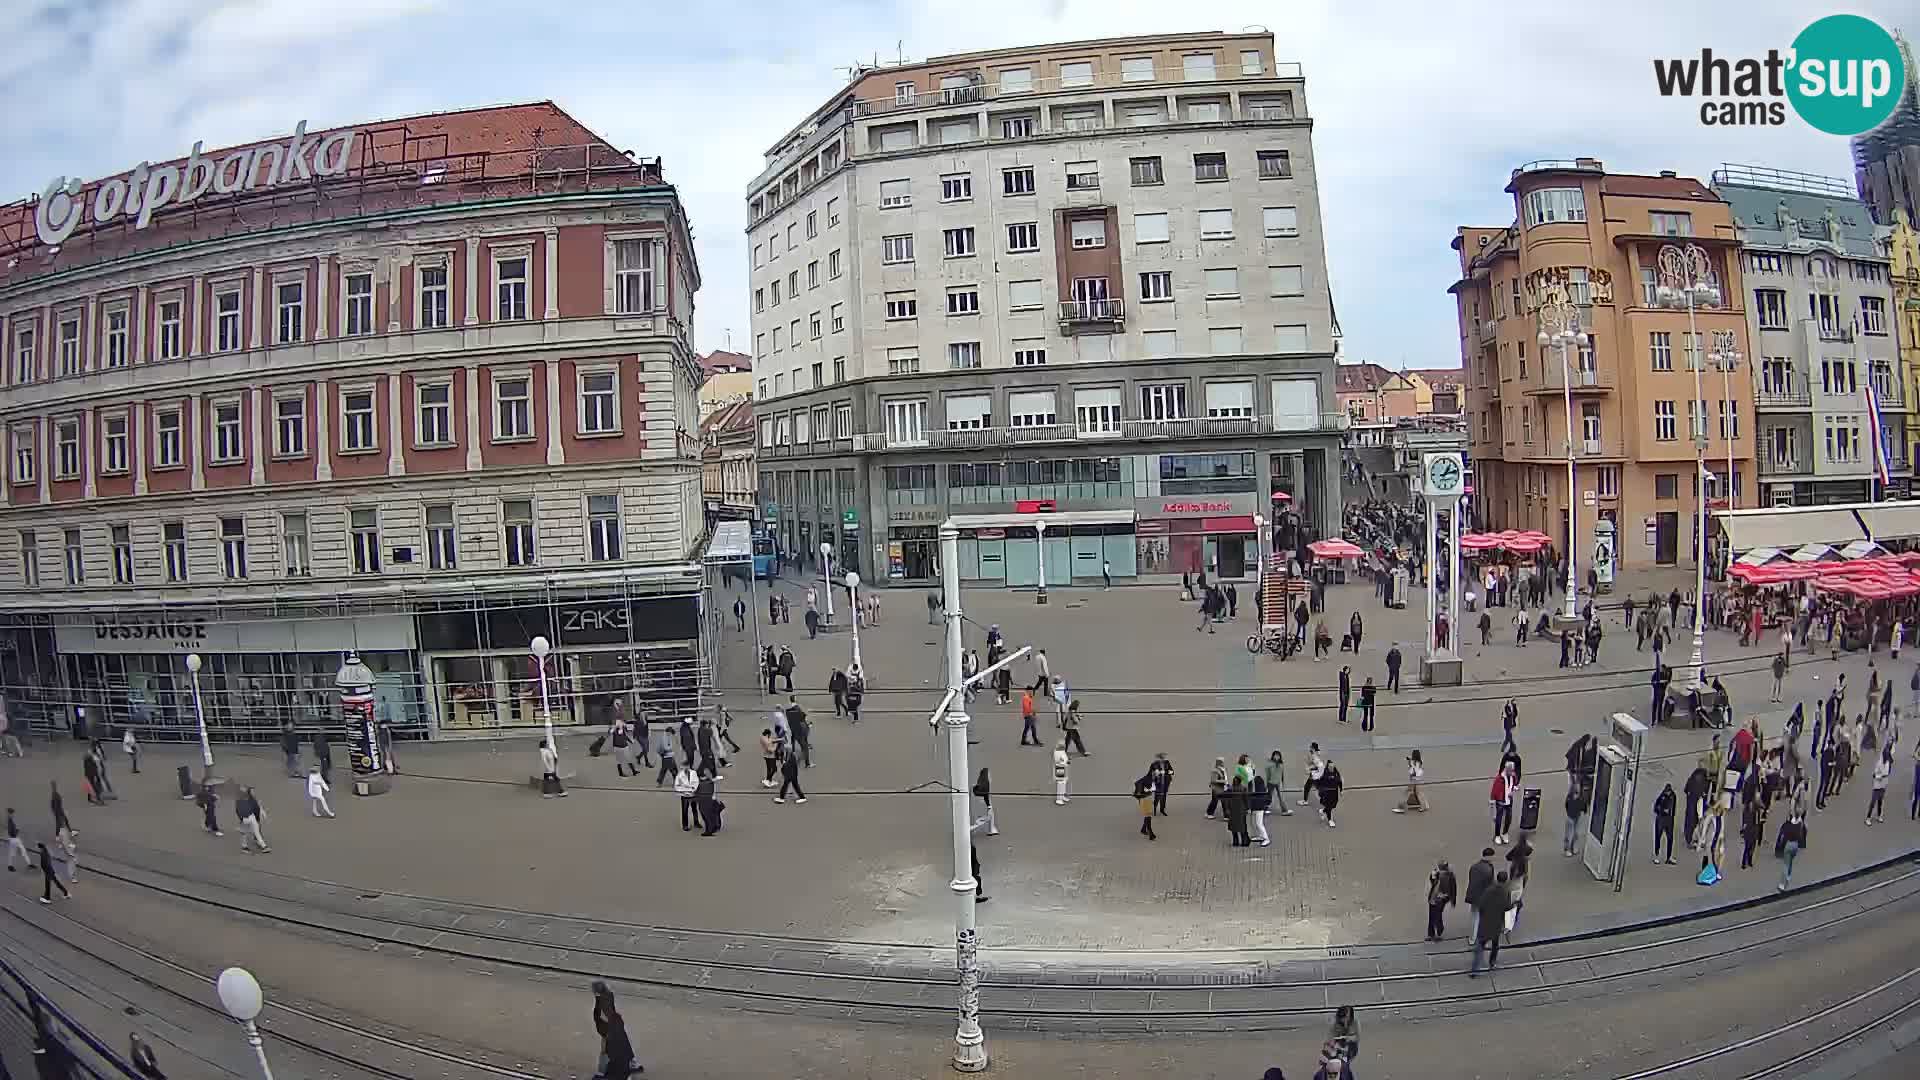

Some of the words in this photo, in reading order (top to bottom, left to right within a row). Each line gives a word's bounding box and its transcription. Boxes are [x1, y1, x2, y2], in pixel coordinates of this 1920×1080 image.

[1201, 500, 1232, 512] Bank
[94, 617, 208, 640] DESSANGE
[561, 607, 630, 631] ZAKS
